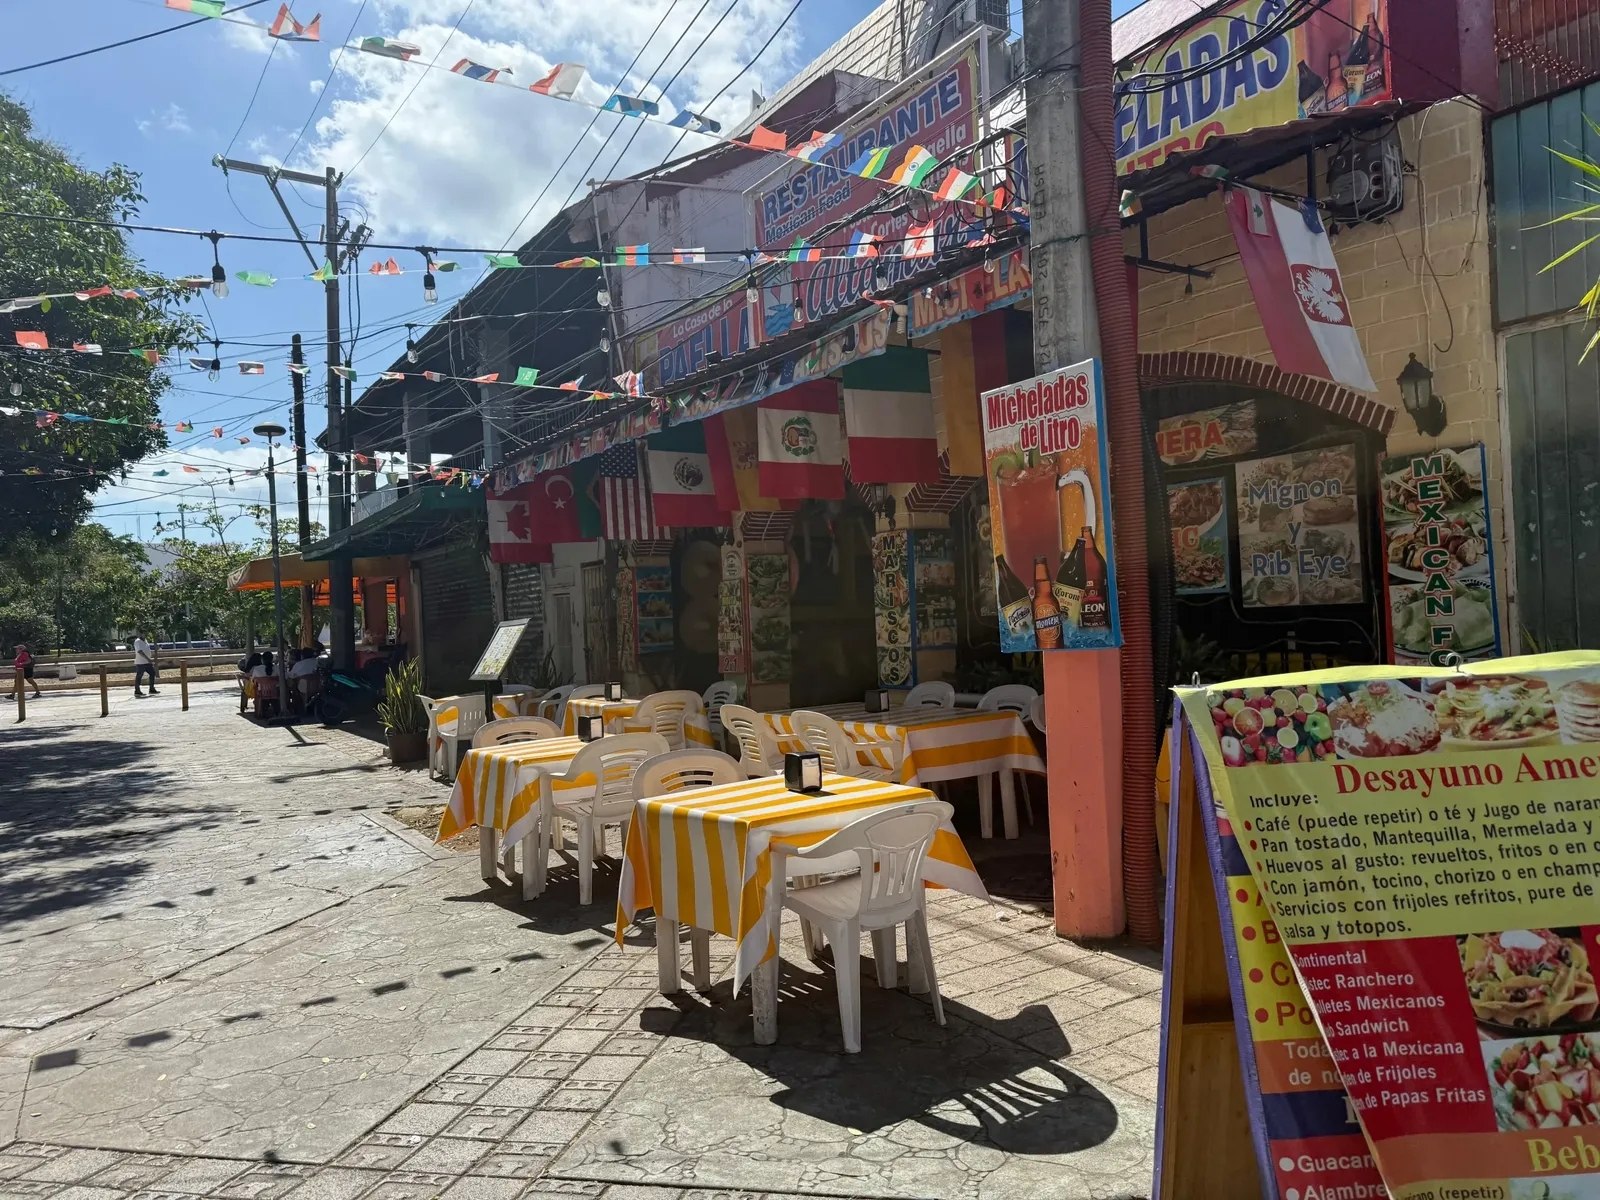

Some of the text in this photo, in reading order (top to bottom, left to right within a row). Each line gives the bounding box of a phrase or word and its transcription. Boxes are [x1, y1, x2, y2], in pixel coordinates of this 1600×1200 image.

[765, 205, 816, 246] Mexican
[817, 180, 851, 216] Food
[673, 298, 733, 338] La Casa de la
[986, 371, 1090, 432] Micheladas
[1020, 415, 1081, 455] de Litro
[1249, 477, 1343, 511] Mignon
[1286, 521, 1302, 549] y
[1411, 453, 1456, 617] MEXICAN
[1251, 549, 1347, 579] Rib Eye
[882, 535, 900, 682] MARISCOS
[1055, 587, 1081, 603] Corona
[1331, 752, 1600, 798] Desayuno Ame
[1249, 793, 1319, 808] Incluye:
[1255, 815, 1290, 832] Café
[1298, 812, 1358, 832] (puede
[1364, 806, 1422, 827] repetir)
[1429, 810, 1438, 821] o
[1444, 804, 1461, 820] té
[1467, 807, 1476, 822] y
[1483, 803, 1520, 820] Jugo
[1526, 800, 1546, 814] de
[1261, 819, 1592, 852] Pan tostado, Mantequilla, Mermelada y
[1266, 859, 1324, 874] Huevos
[1331, 855, 1347, 870] al
[1355, 852, 1405, 872] gusto:
[1412, 847, 1493, 865] revueltos,
[1498, 844, 1542, 860] fritos
[1549, 844, 1559, 855] o
[1565, 842, 1586, 854] en
[1270, 880, 1297, 895] Con
[1303, 875, 1365, 897] jamón,
[1372, 872, 1429, 889] tocino,
[1434, 868, 1496, 885] chorizo
[1502, 868, 1511, 880] o
[1517, 866, 1537, 879] en
[1277, 881, 1593, 916] Servicios con frijoles refritos, pure de
[1284, 919, 1412, 940] salsa y totopos.
[1335, 971, 1414, 989] Ranchero
[1356, 994, 1445, 1011] Mexicanos
[1336, 1017, 1410, 1037] Sandwich
[1352, 1047, 1360, 1060] a
[1363, 1042, 1378, 1058] la
[1382, 1040, 1465, 1057] Mexicana
[1288, 1067, 1312, 1086] de
[1357, 1069, 1371, 1084] de
[1375, 1065, 1437, 1084] Frijoles
[1365, 1092, 1378, 1109] de
[1381, 1089, 1429, 1109] Papas
[1435, 1087, 1486, 1103] Fritas
